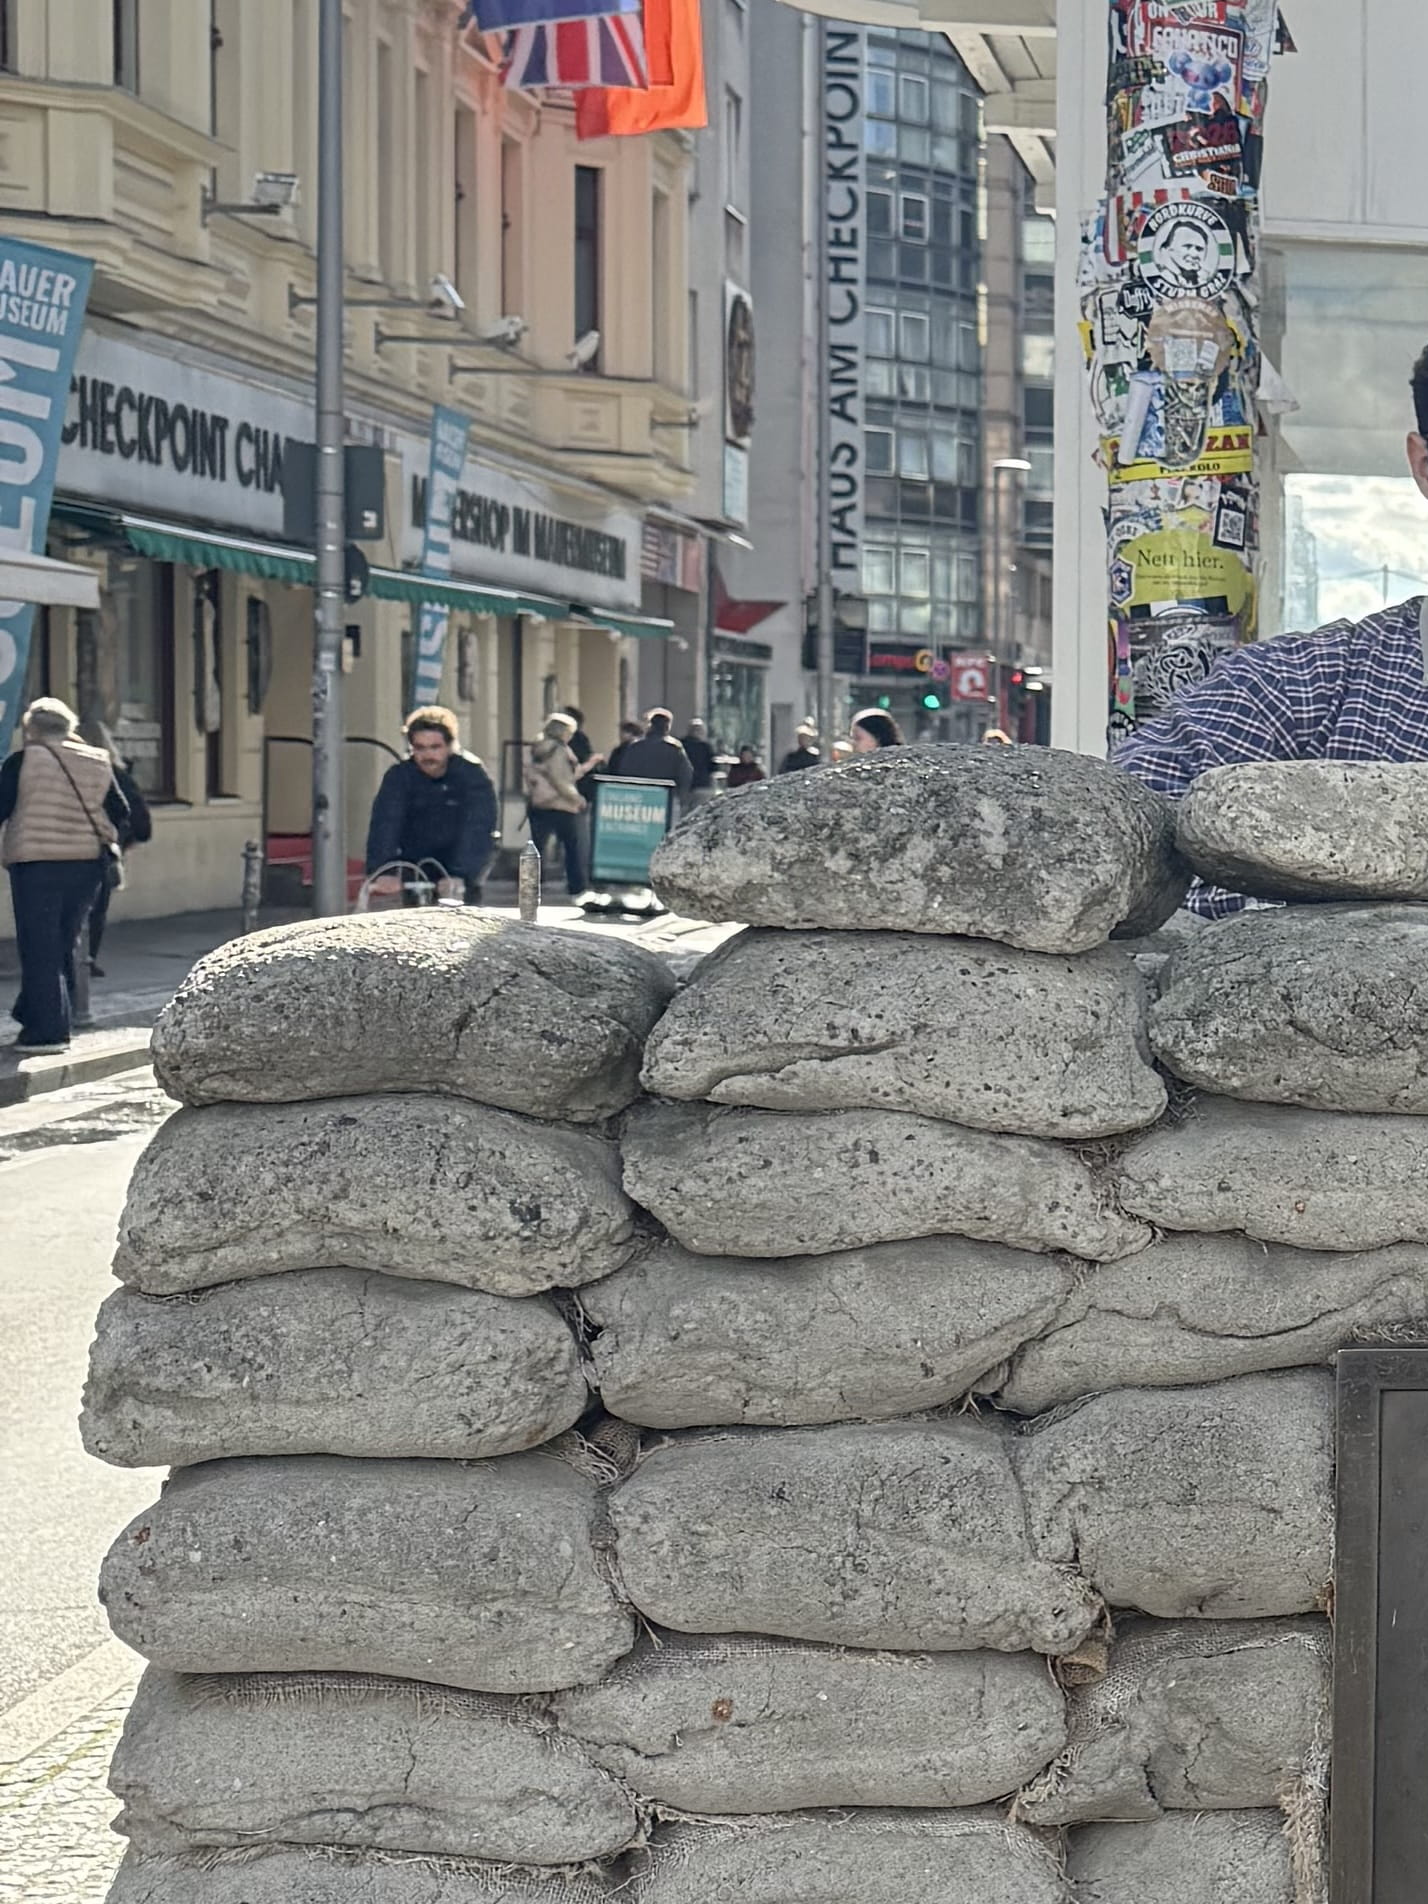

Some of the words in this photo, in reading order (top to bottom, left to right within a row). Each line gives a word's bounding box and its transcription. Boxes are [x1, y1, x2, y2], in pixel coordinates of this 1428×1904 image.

[826, 30, 861, 325] CHECKPOIN
[1148, 203, 1219, 232] NORDKURVE
[828, 339, 860, 427] AM
[62, 374, 230, 483] CHECKPOINT
[235, 421, 286, 496] CHA
[828, 440, 860, 571] HAUS
[1137, 549, 1174, 568] Nett
[1183, 549, 1225, 570] hier.
[601, 804, 667, 825] MUSEUM
